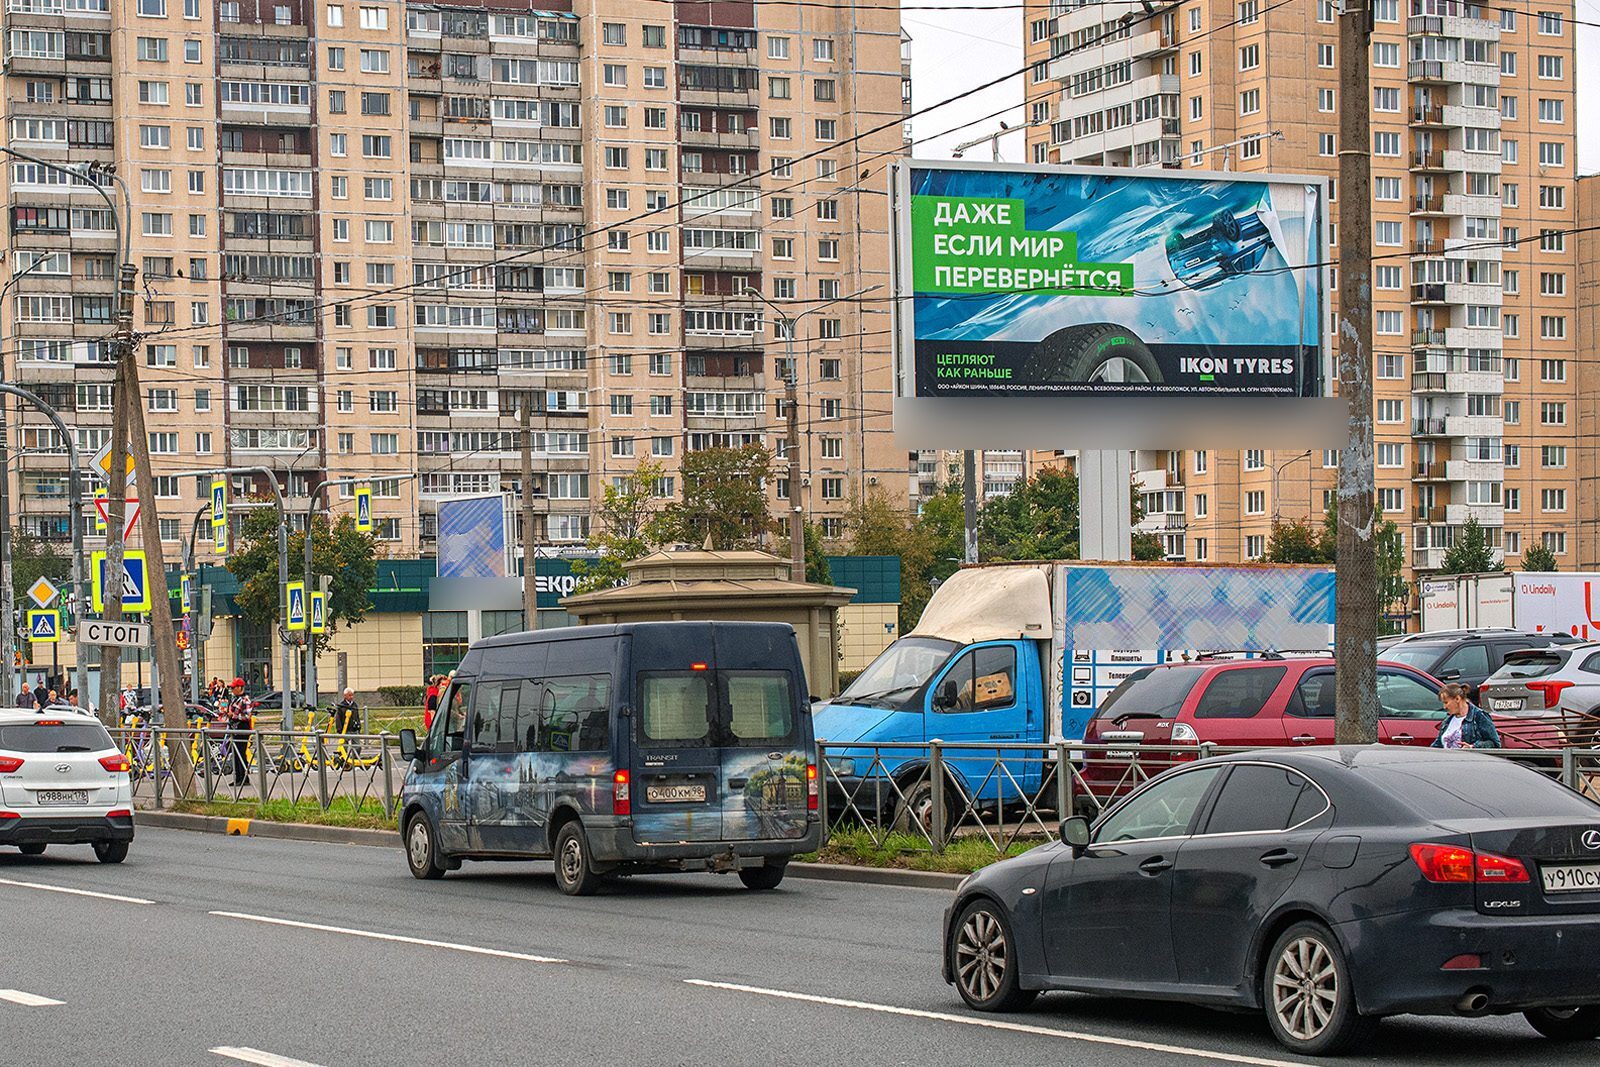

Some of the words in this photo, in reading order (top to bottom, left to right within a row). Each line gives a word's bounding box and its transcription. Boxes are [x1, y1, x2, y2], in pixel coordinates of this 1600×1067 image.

[934, 203, 1011, 226] ДАЖЕ
[934, 234, 1002, 256] ЕСЛИ
[1010, 237, 1064, 258] МИР
[935, 264, 1121, 290] ПЕРЕВЕРНЁТСЯ
[937, 354, 995, 366] ЦЕПЛЯЮТ
[1180, 357, 1228, 374] IKON
[1233, 358, 1294, 374] TYRES
[937, 368, 961, 378] КАК
[964, 368, 1012, 378] РАНЬШЕ
[89, 625, 139, 642] СТОП
[1484, 900, 1521, 908] LEXUS
